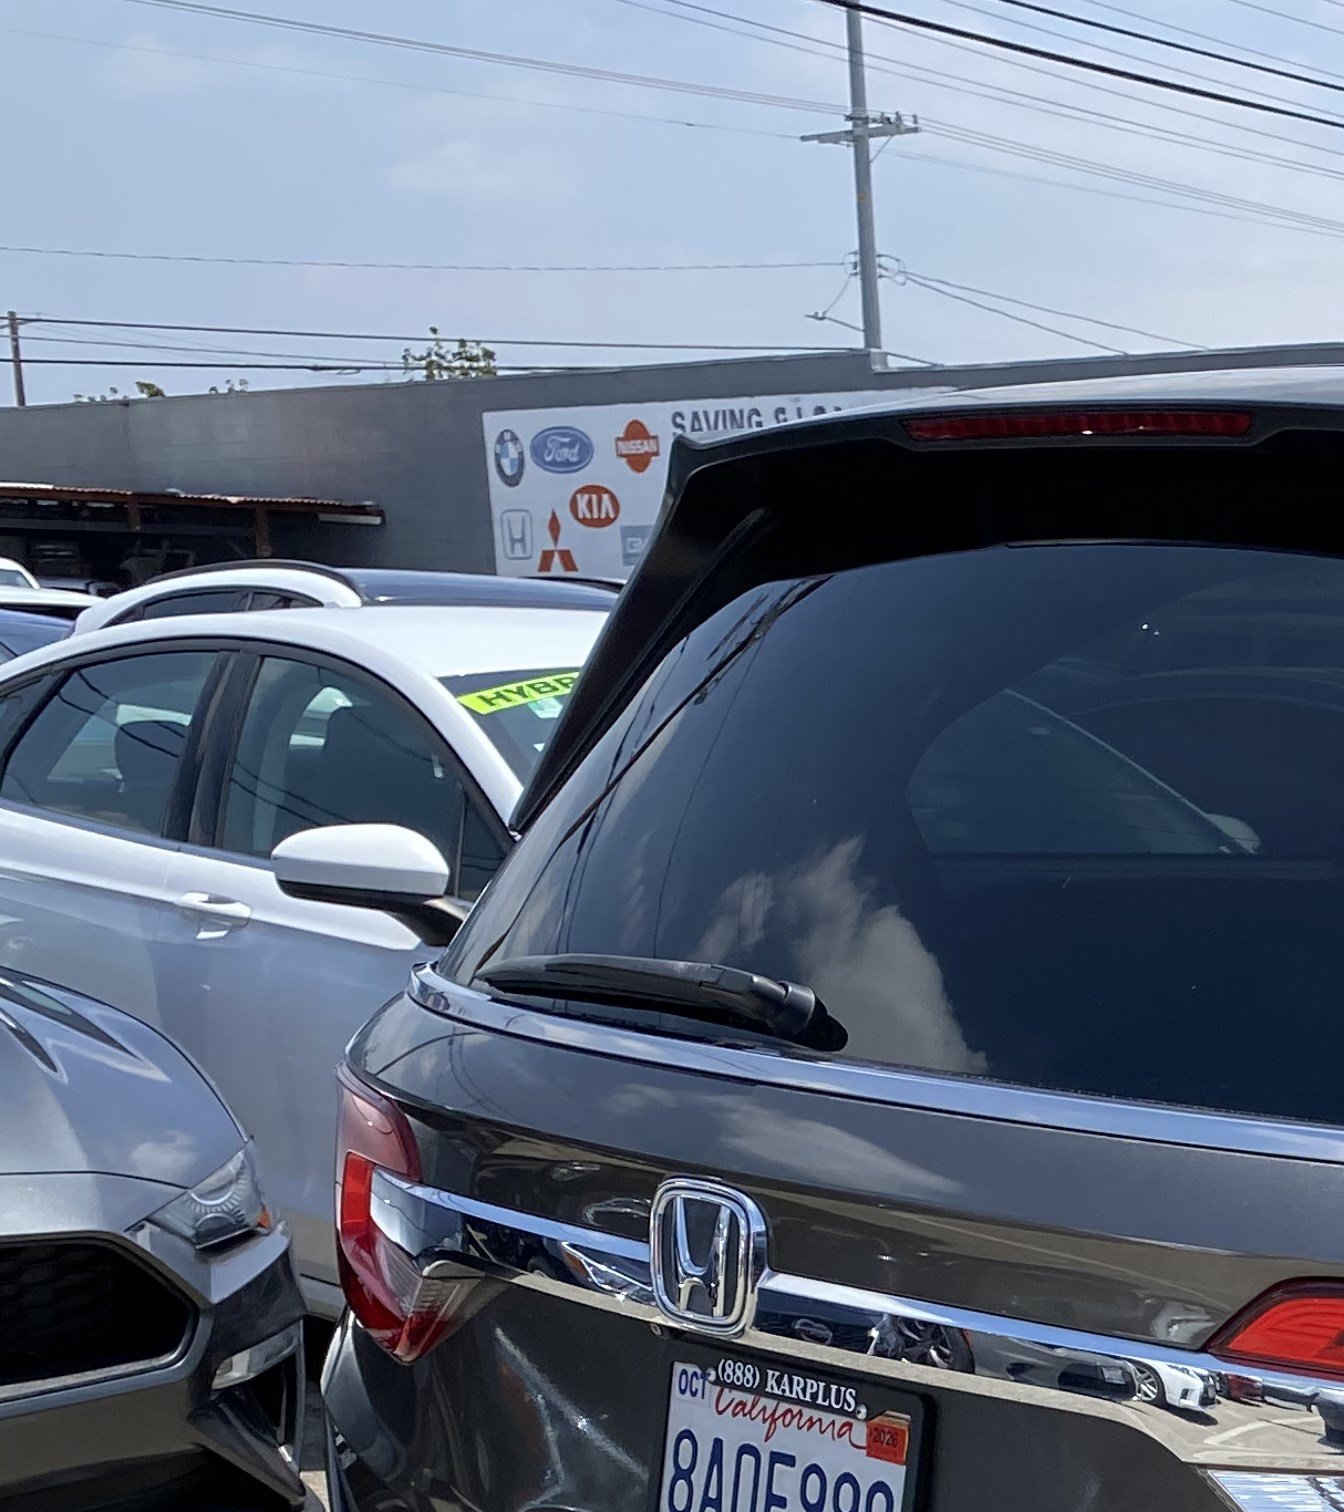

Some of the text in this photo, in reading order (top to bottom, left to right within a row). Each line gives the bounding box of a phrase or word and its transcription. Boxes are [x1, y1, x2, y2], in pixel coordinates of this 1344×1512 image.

[671, 407, 764, 434] SAVING
[544, 435, 580, 463] Ford
[575, 493, 615, 520] KIA
[718, 1358, 857, 1412] (888) KARPLUS
[715, 1386, 867, 1450] California
